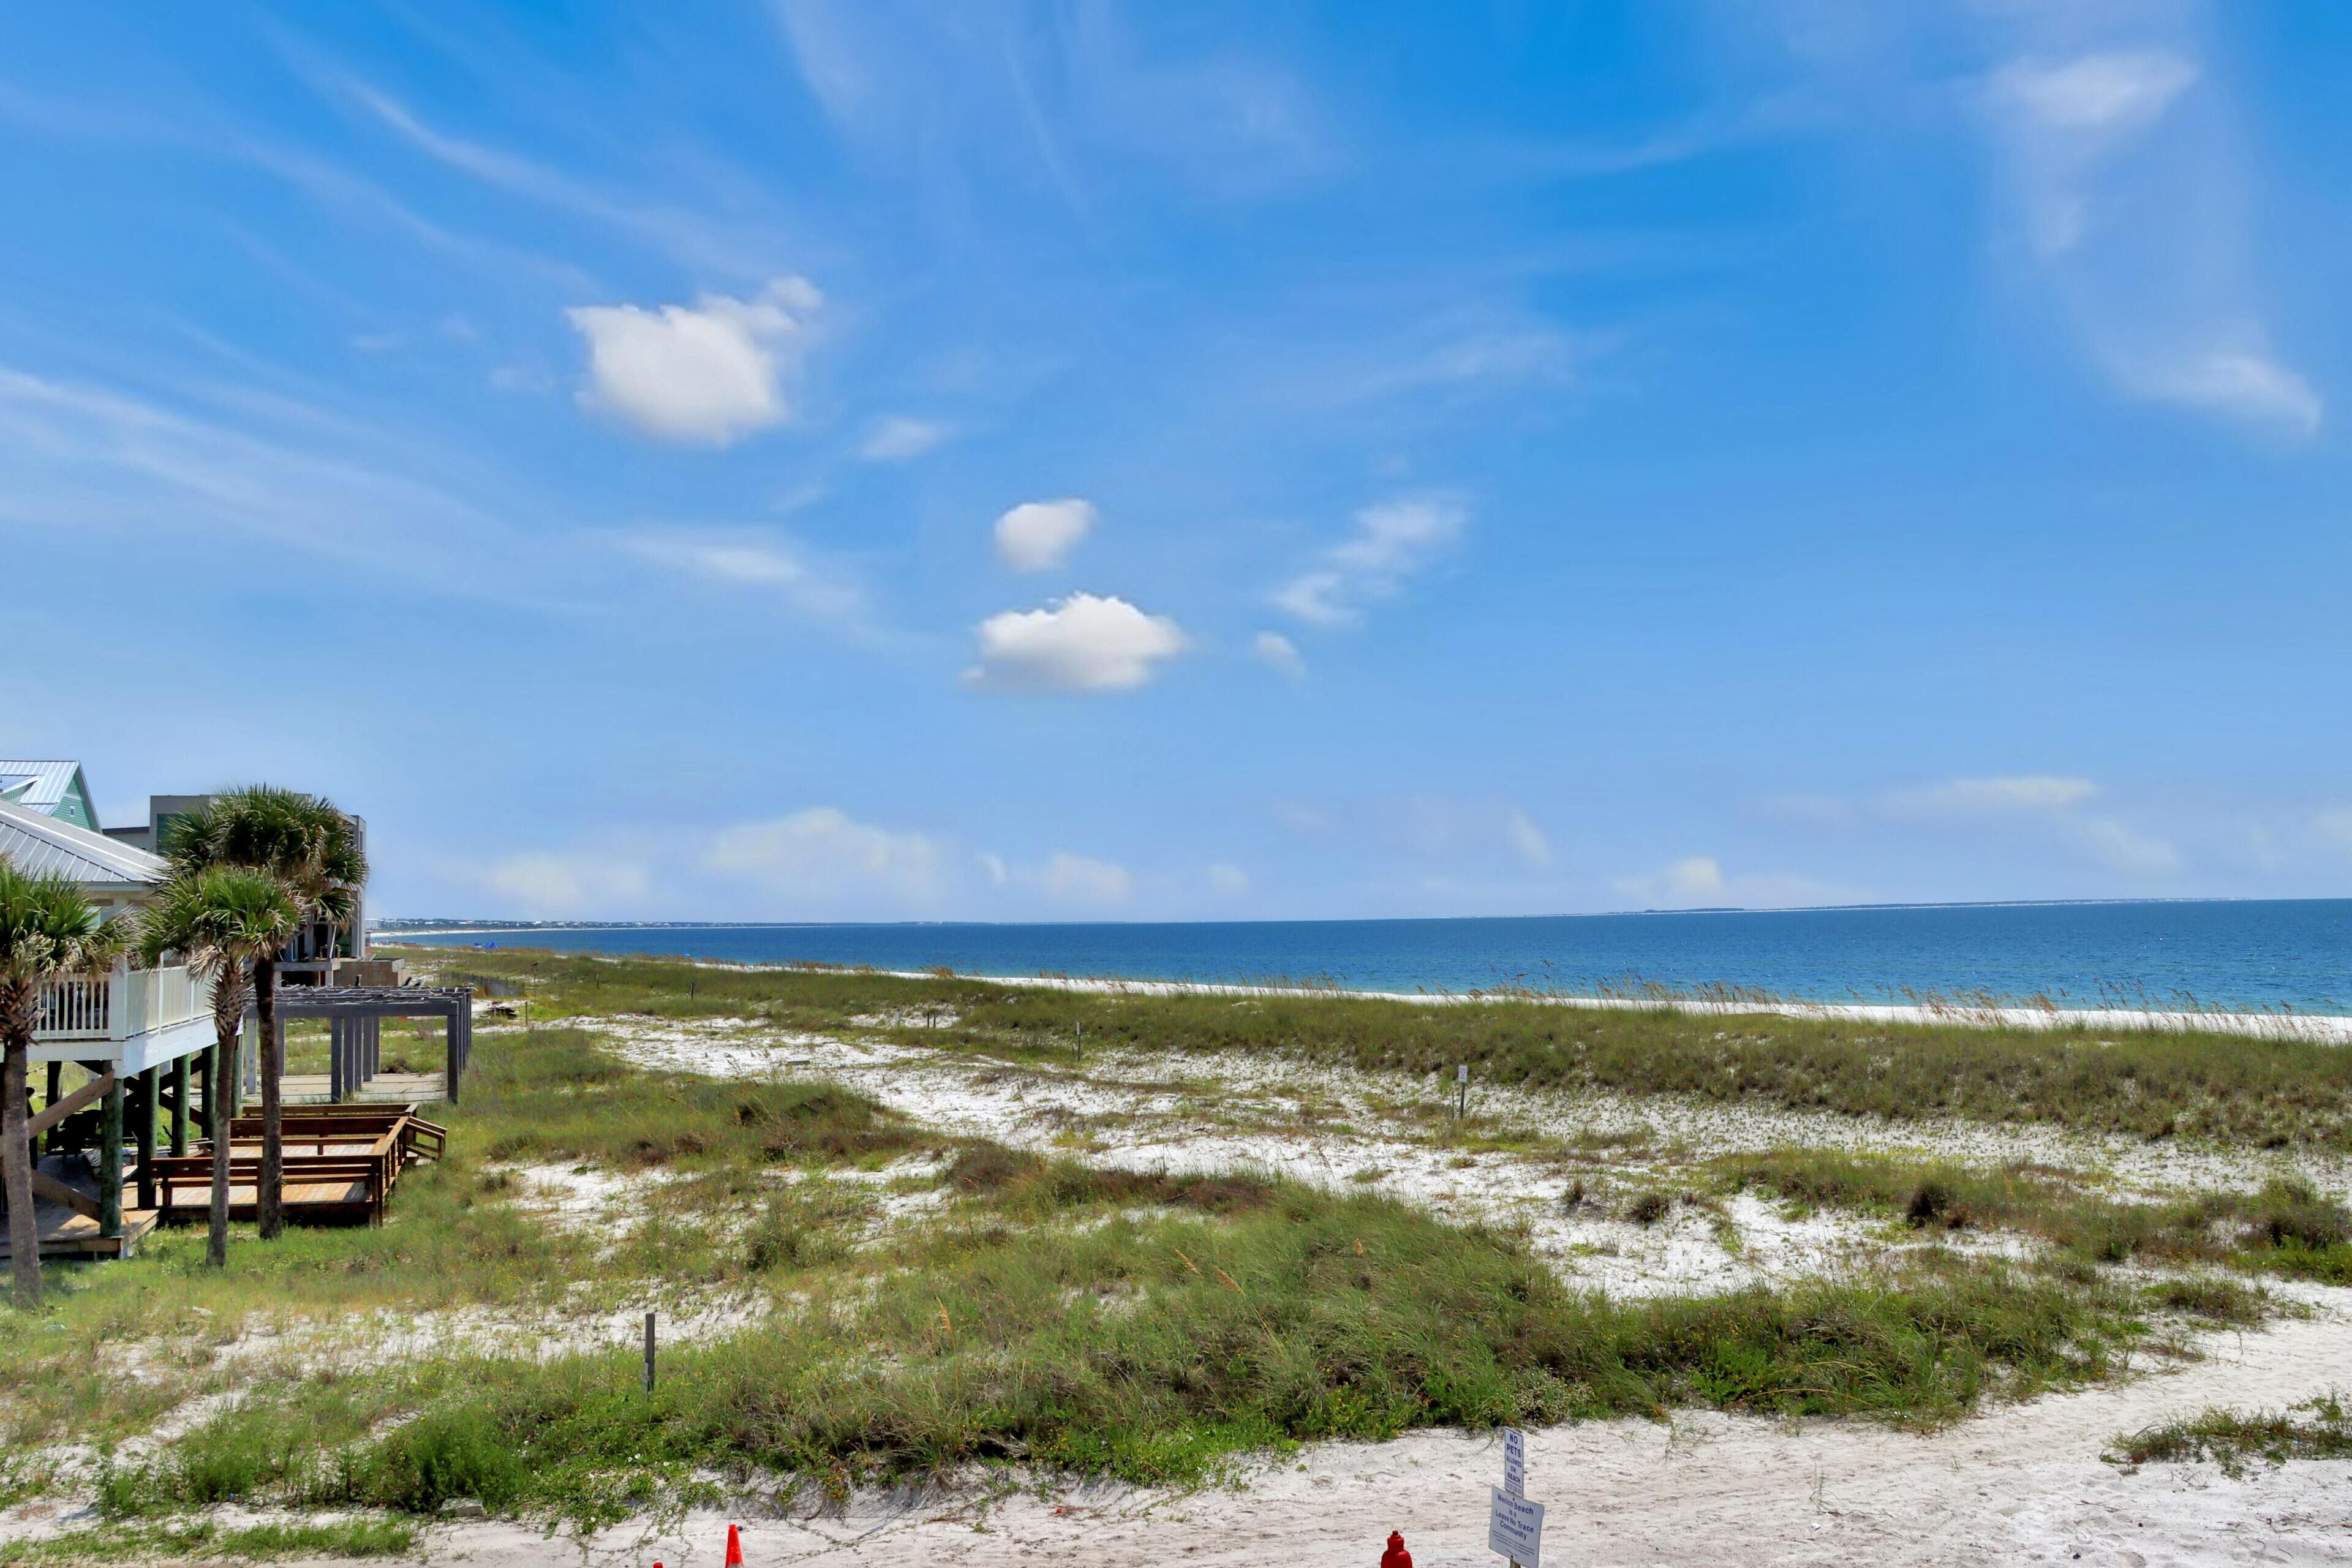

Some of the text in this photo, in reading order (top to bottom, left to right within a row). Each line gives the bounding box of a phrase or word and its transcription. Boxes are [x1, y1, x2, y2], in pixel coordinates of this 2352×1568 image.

[1510, 1433, 1518, 1444] NO
[1507, 1443, 1521, 1458] PETS
[1506, 1455, 1522, 1468] ALLOWED
[1507, 1472, 1521, 1485] BEACH
[1498, 1494, 1534, 1515] Mexico Beach
[1496, 1509, 1534, 1533] Leave No Trace
[1500, 1520, 1528, 1541] Community
